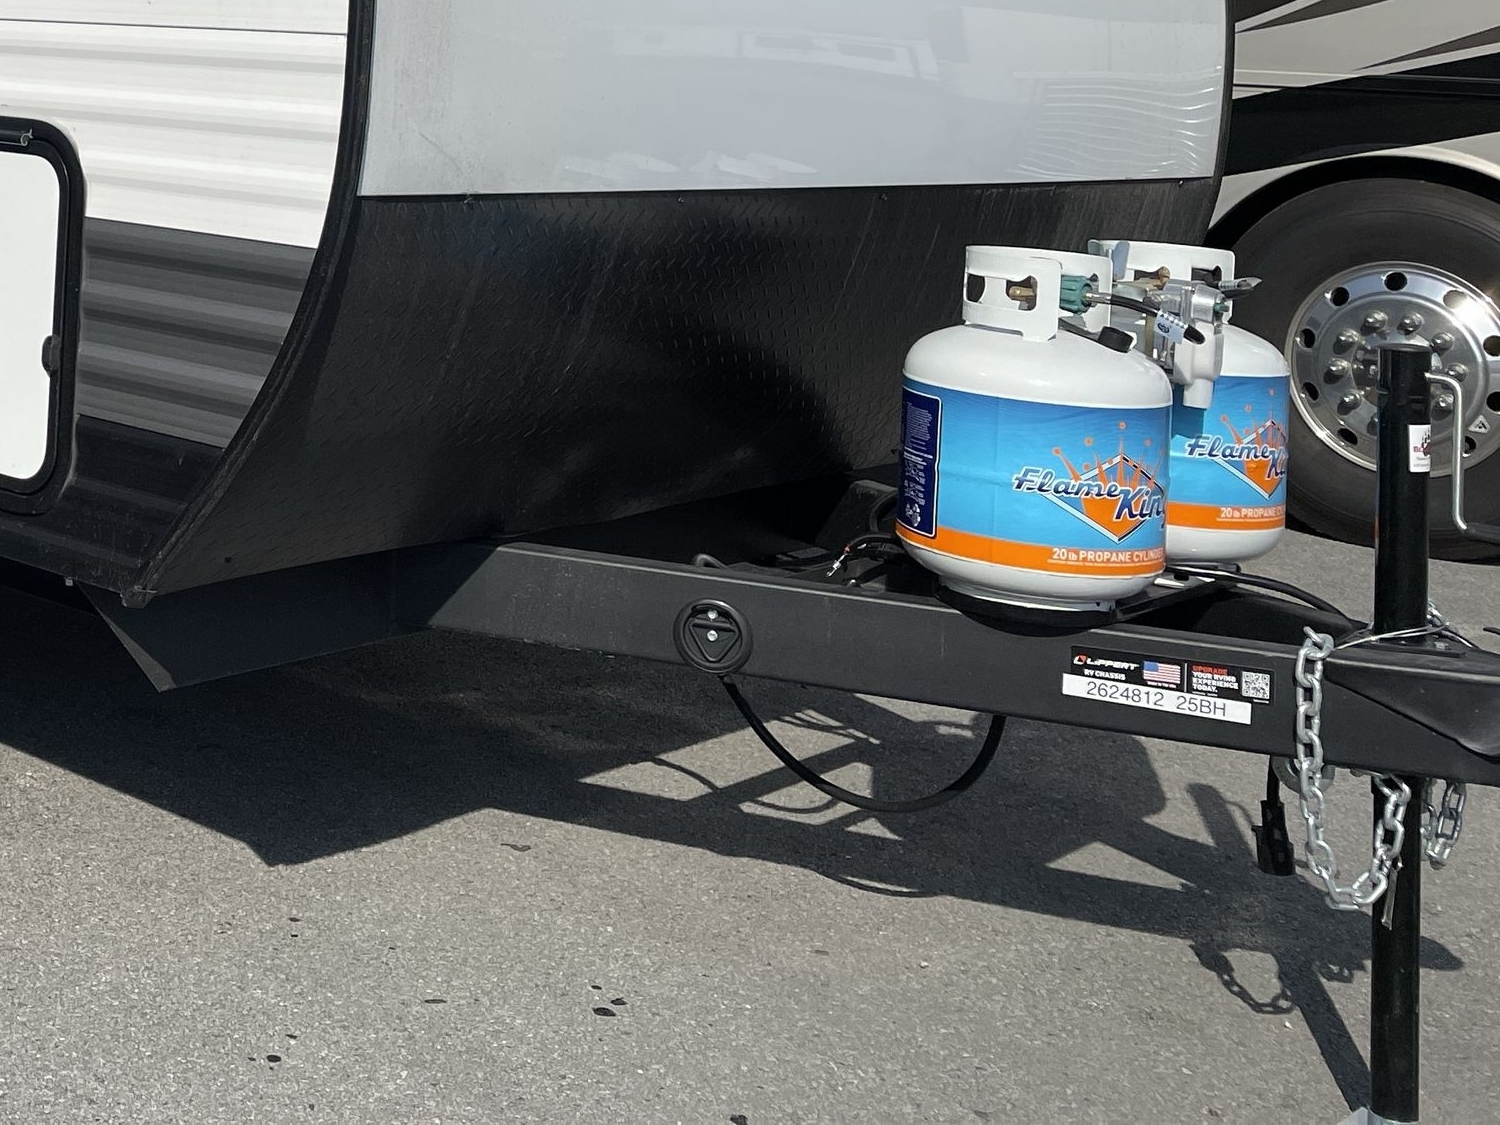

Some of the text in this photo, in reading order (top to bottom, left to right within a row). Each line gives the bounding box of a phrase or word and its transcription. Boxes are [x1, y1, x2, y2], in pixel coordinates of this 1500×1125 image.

[1185, 434, 1269, 459] Flame
[1012, 466, 1119, 498] Flame
[1220, 507, 1232, 518] 20
[1241, 506, 1276, 518] PROPANE
[1052, 548, 1066, 560] 20
[1079, 550, 1132, 563] PROPANE
[1095, 670, 1126, 681] CHASSIS
[1192, 665, 1228, 676] UPGRADE
[1192, 671, 1213, 680] YOUR
[1192, 677, 1239, 690] EXPERIENCE
[1192, 683, 1218, 693] TODAY.
[1086, 681, 1226, 717] 2624812 25BH
